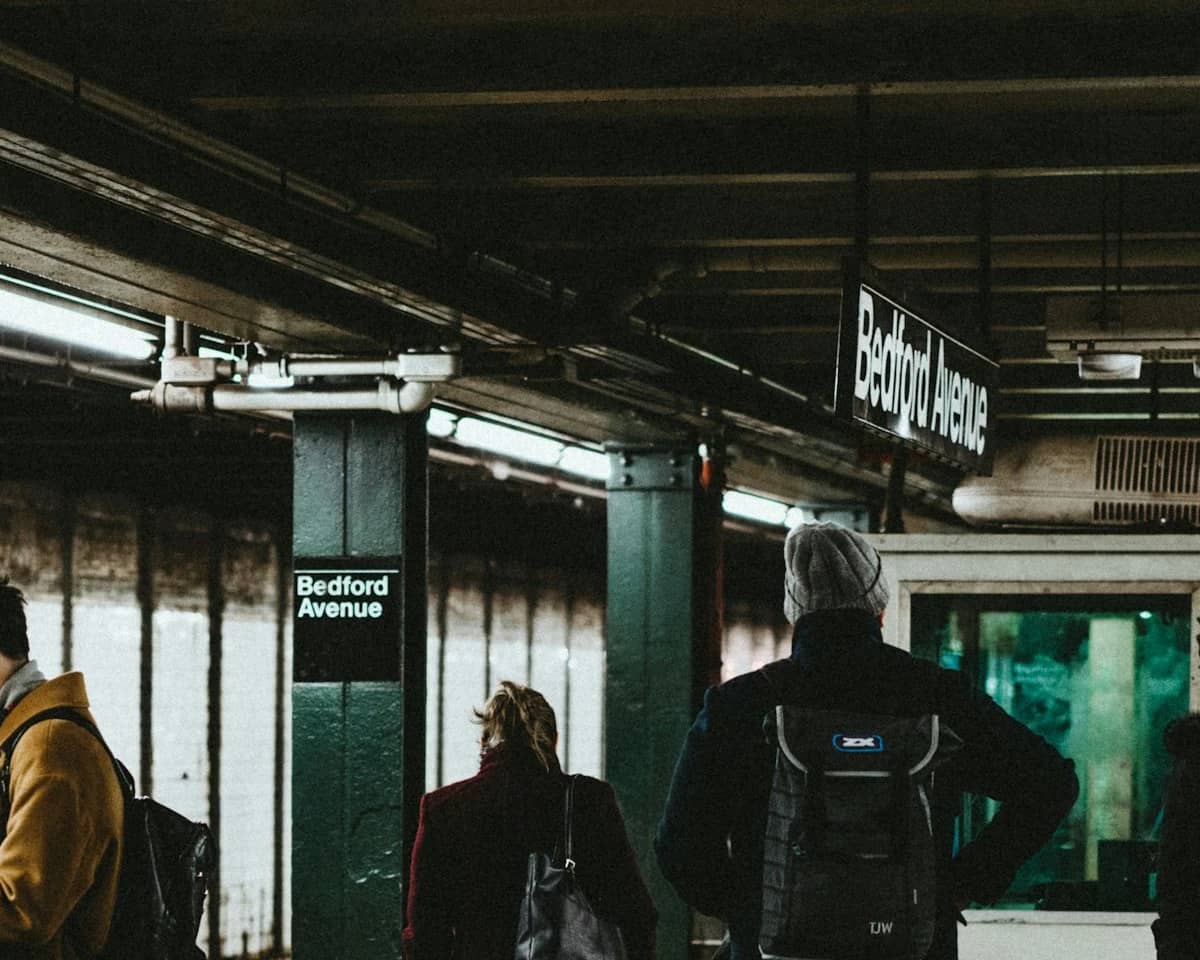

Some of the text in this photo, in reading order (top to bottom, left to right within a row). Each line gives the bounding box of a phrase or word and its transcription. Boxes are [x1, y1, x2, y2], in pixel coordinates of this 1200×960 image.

[854, 290, 988, 456] Bedford Avenue
[297, 575, 388, 596] Bedford
[298, 597, 383, 618] Avenue
[869, 921, 893, 935] TJW
